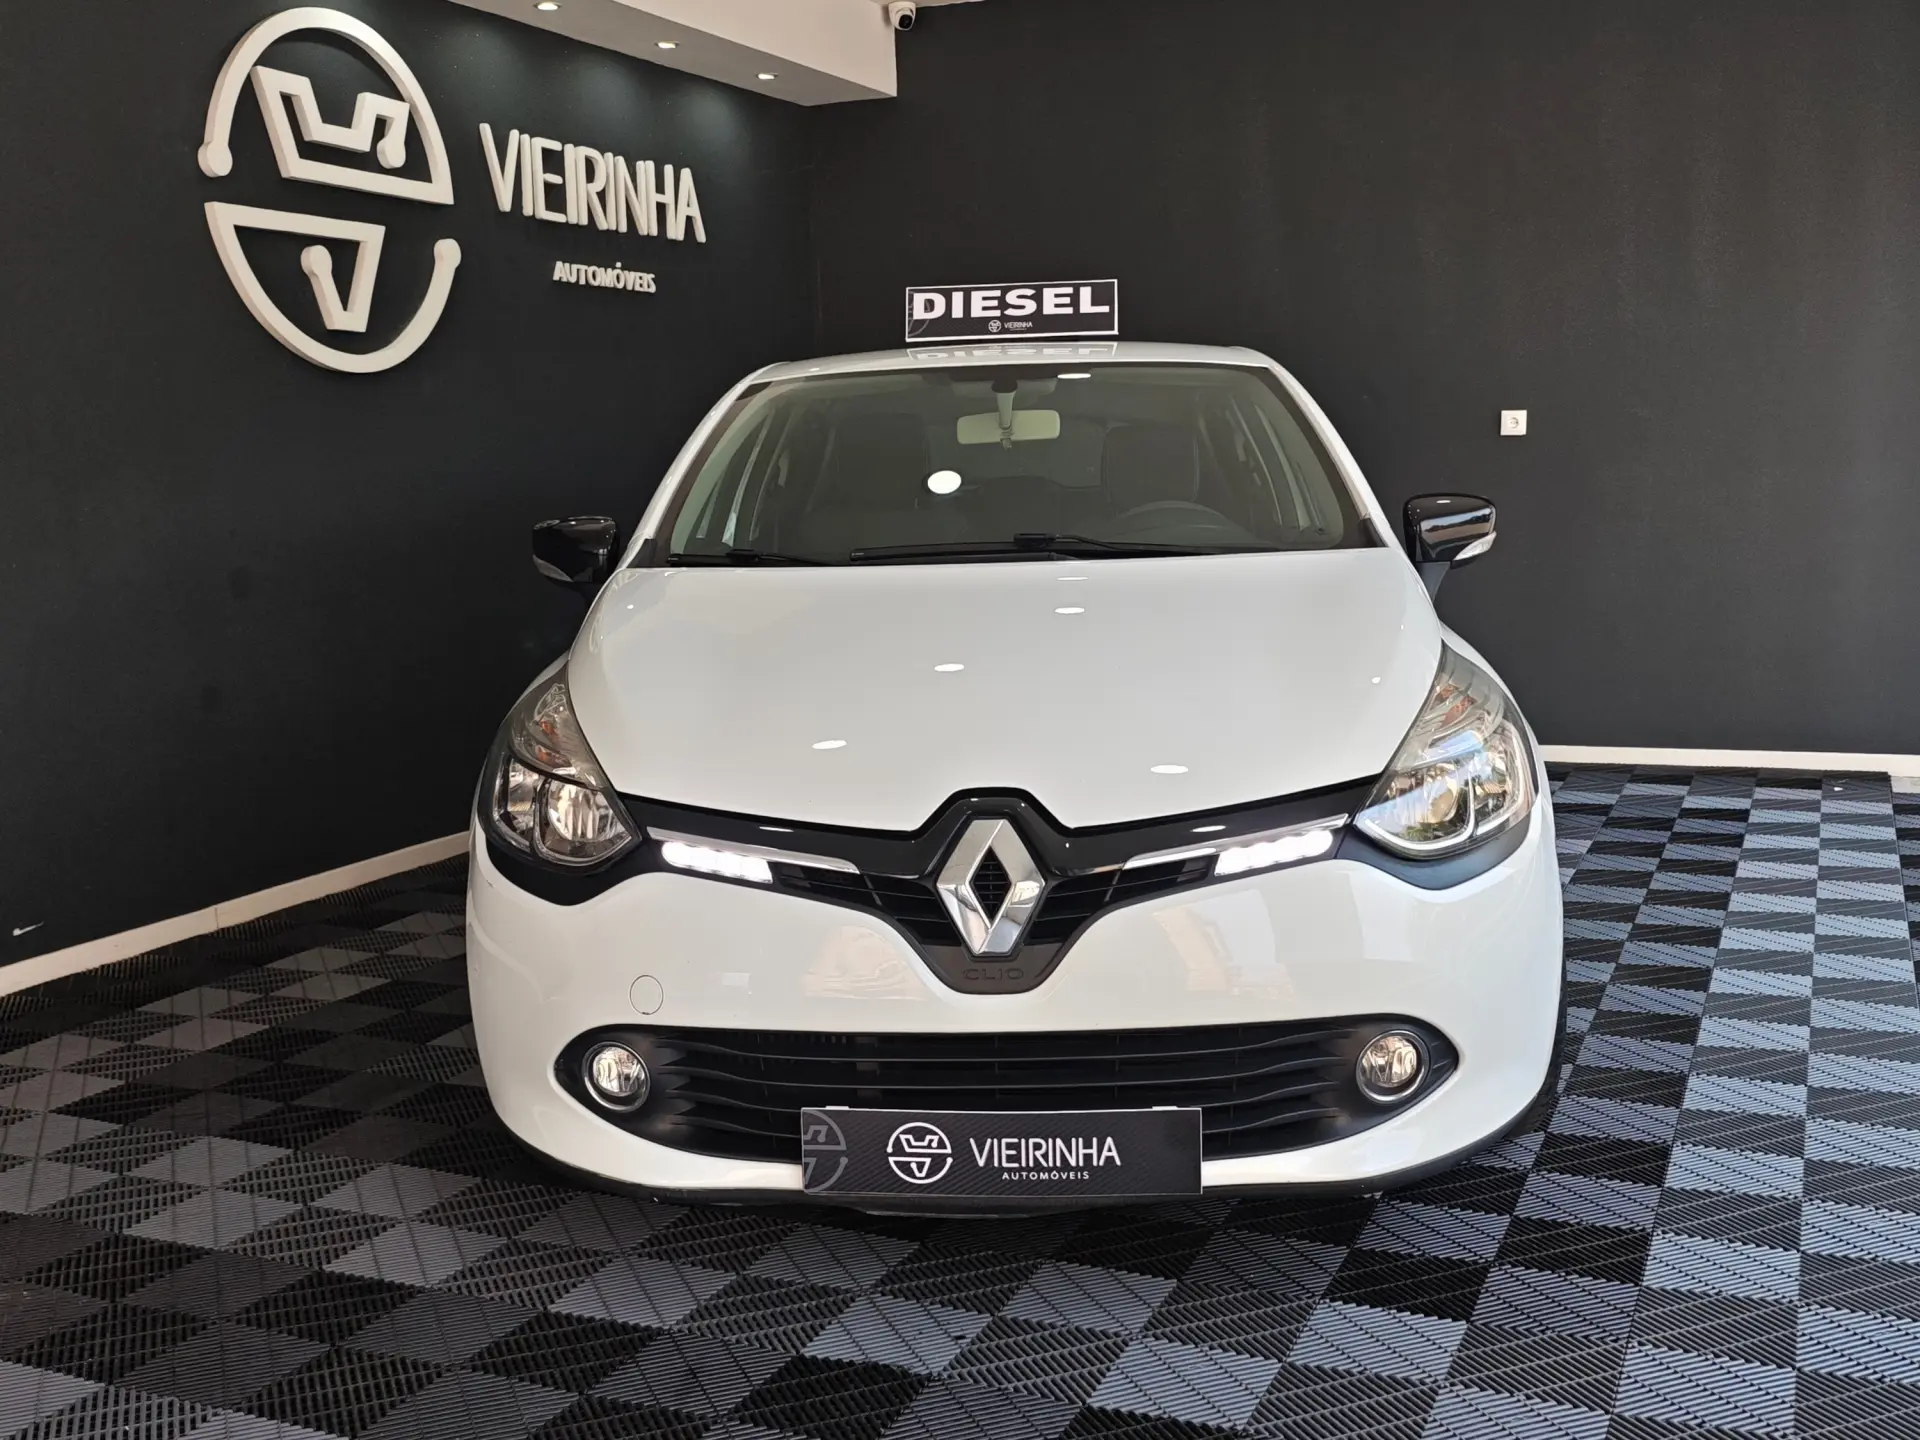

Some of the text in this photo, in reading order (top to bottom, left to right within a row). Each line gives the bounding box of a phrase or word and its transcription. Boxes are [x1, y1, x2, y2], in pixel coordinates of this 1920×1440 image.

[479, 123, 706, 243] VIEIRINHA
[553, 261, 656, 293] AUTOMÓVEIS
[913, 286, 1110, 320] DIESEL
[963, 968, 1024, 980] CLIO
[969, 1136, 1121, 1168] VIEIRINHA
[1002, 1170, 1090, 1180] AUTOMÓVEIS
